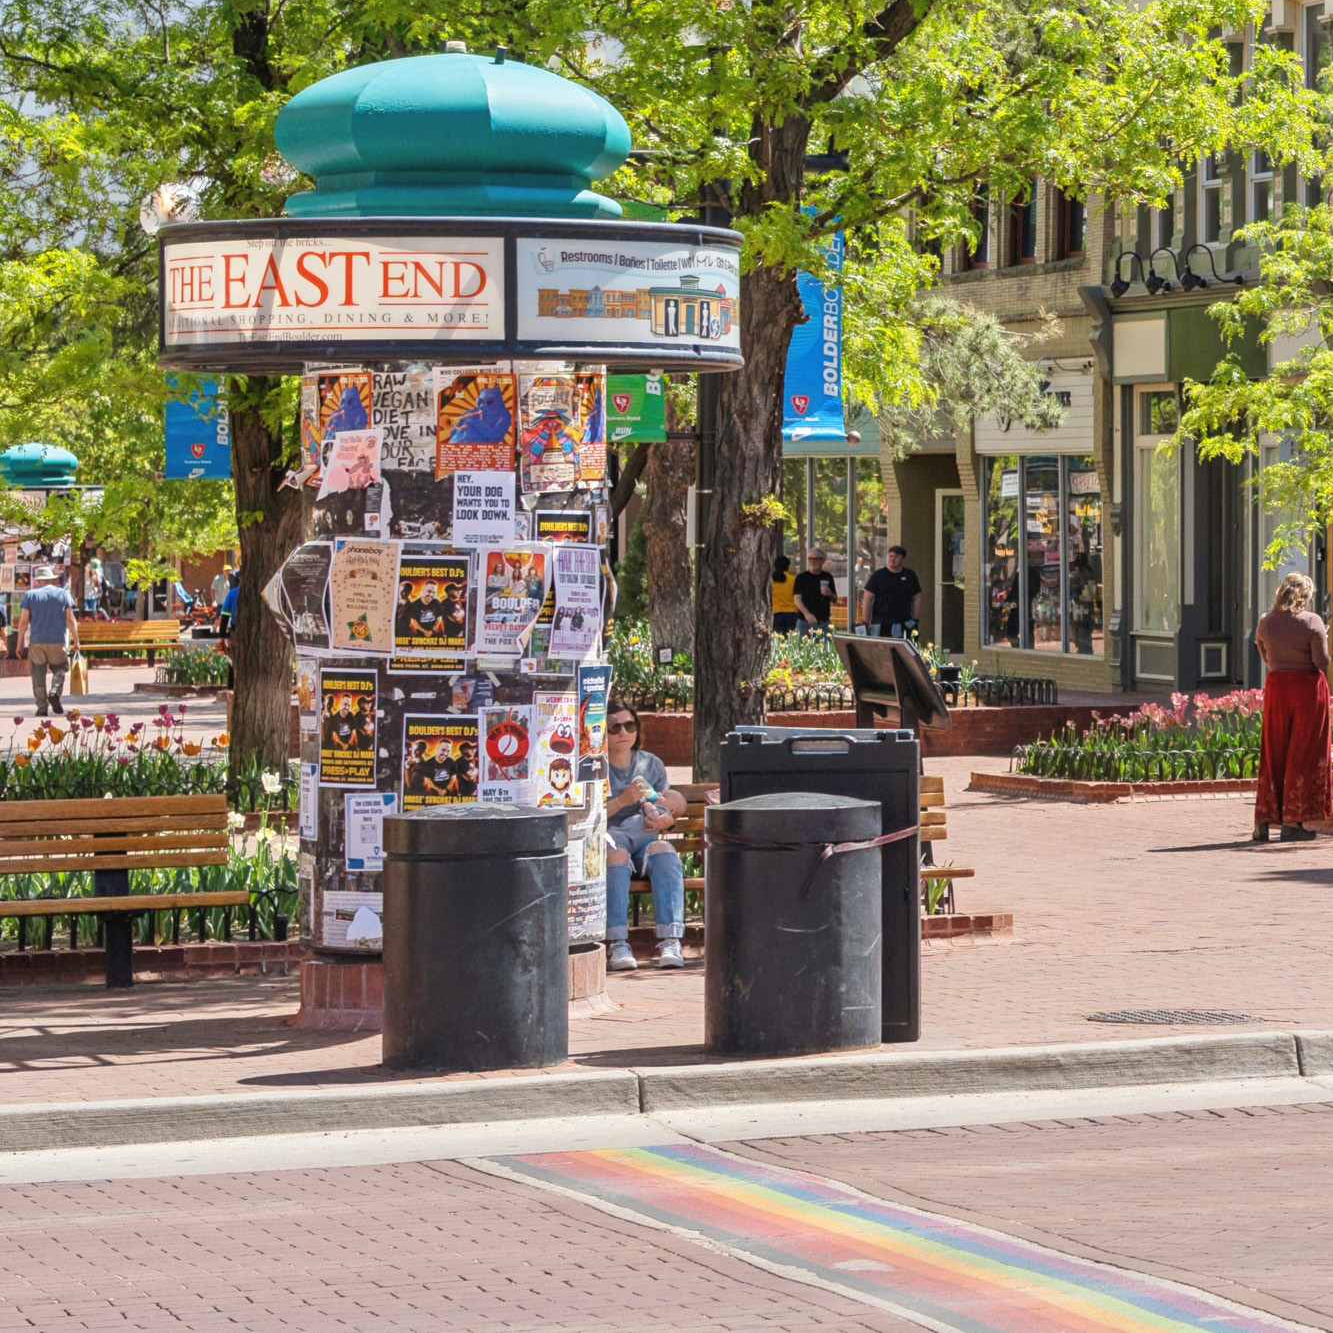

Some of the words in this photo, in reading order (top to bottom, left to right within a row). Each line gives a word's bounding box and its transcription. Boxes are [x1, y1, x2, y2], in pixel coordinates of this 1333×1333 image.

[561, 251, 613, 264] Restrooms
[620, 254, 646, 268] Baños
[651, 258, 678, 270] Toilette
[169, 265, 214, 305] THE
[221, 251, 371, 310] EAST
[378, 261, 487, 299] END
[230, 313, 314, 326] SHOPPING,
[324, 313, 392, 324] DINING
[404, 313, 414, 323] &
[427, 313, 490, 324] MORE!
[373, 374, 407, 393] RAW
[372, 391, 429, 409] VEGAN
[373, 409, 414, 426] DIET
[383, 425, 411, 440] OVE
[420, 425, 437, 437] IN
[381, 440, 414, 460] OUR
[457, 475, 474, 484] HEY.
[457, 486, 482, 497] YOUR
[485, 486, 503, 497] DOG
[456, 499, 482, 508] WANTS
[484, 500, 499, 508] YOU
[501, 500, 510, 508] TO
[456, 510, 480, 521] LOOK
[482, 510, 511, 521] DOWN.
[347, 546, 384, 556] phoneboy
[400, 567, 431, 577] OULDER'S
[432, 568, 448, 577] BEST
[449, 568, 465, 578] DJ's
[492, 597, 540, 610] BOULDER
[439, 636, 447, 646] DJ
[448, 638, 465, 646] MARS
[323, 679, 347, 689] BOULDER'S
[347, 680, 360, 690] BEST
[360, 681, 374, 691] DJ's
[537, 704, 564, 717] TRIVIA
[409, 726, 445, 736] BOULDER'S
[445, 726, 463, 736] BEST
[463, 726, 478, 737] DJ's
[482, 789, 497, 797] MAY
